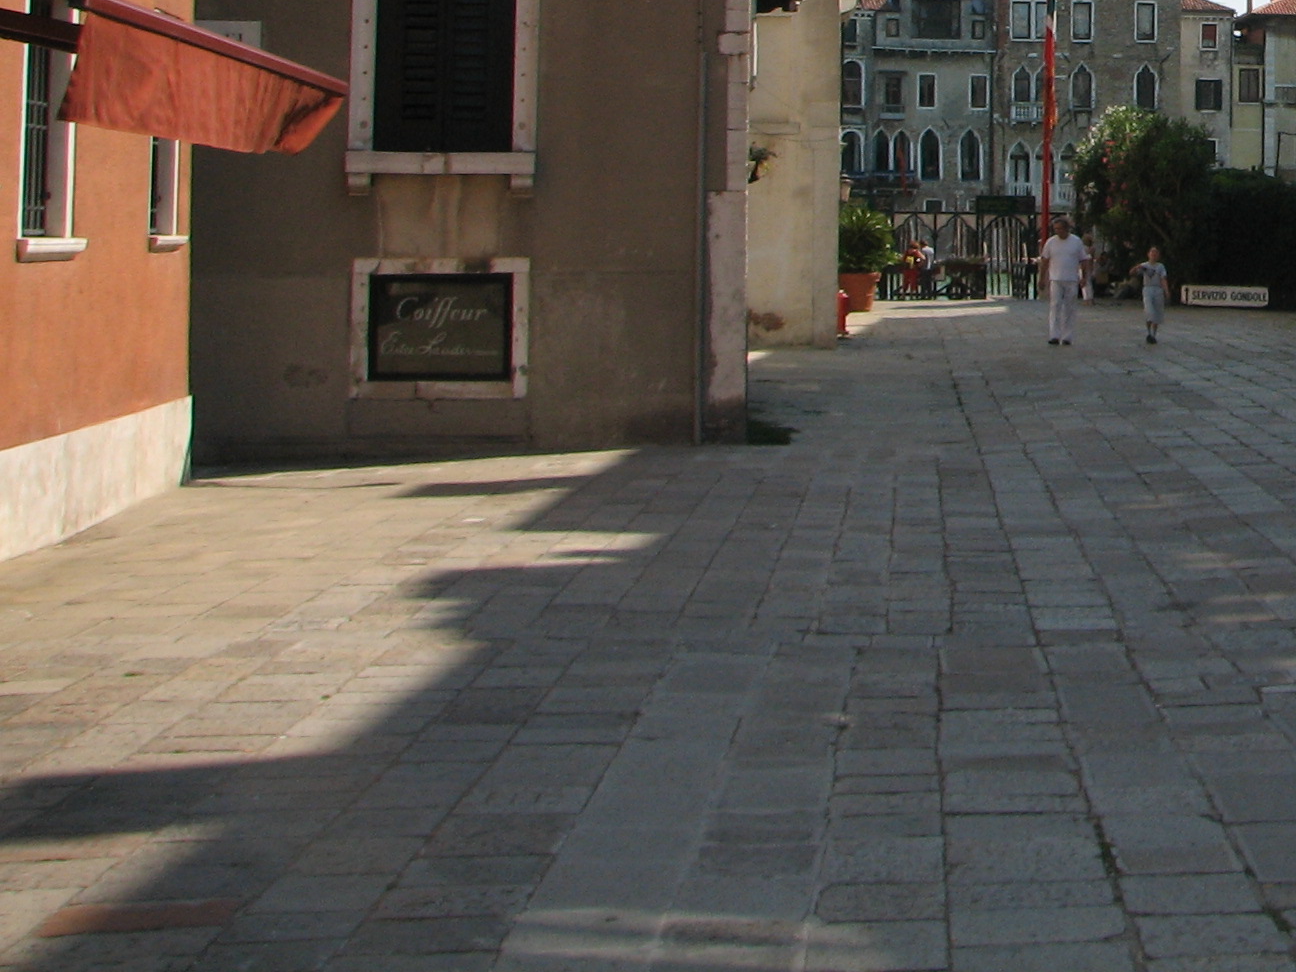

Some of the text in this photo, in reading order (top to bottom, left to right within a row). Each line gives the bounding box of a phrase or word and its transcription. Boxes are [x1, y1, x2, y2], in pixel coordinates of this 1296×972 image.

[1192, 290, 1268, 302] SERVIZIO GONDOLE
[396, 296, 489, 329] Coiffeur
